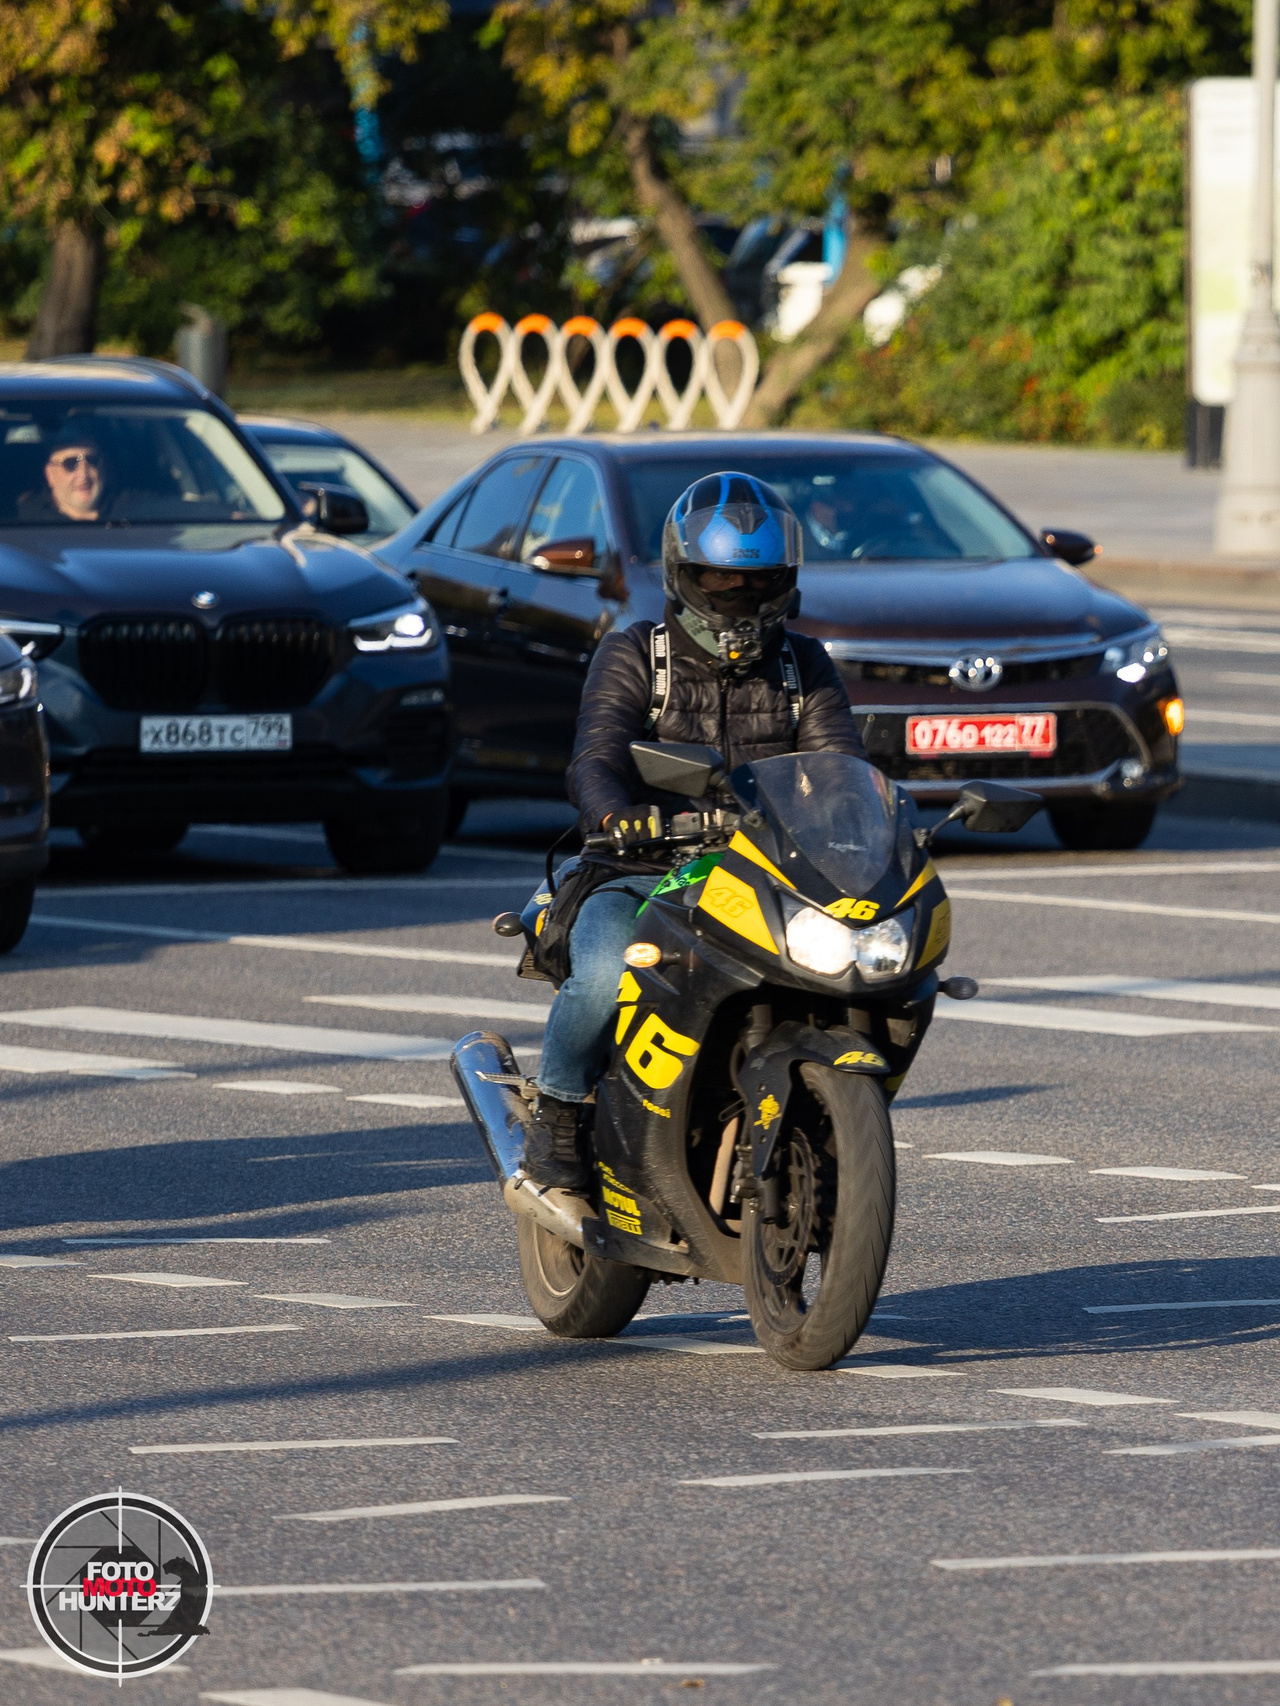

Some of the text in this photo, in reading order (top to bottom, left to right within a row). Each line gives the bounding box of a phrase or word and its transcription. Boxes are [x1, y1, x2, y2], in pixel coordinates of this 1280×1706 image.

[706, 886, 754, 919] 46
[821, 897, 880, 921] 46
[833, 1050, 885, 1067] 46
